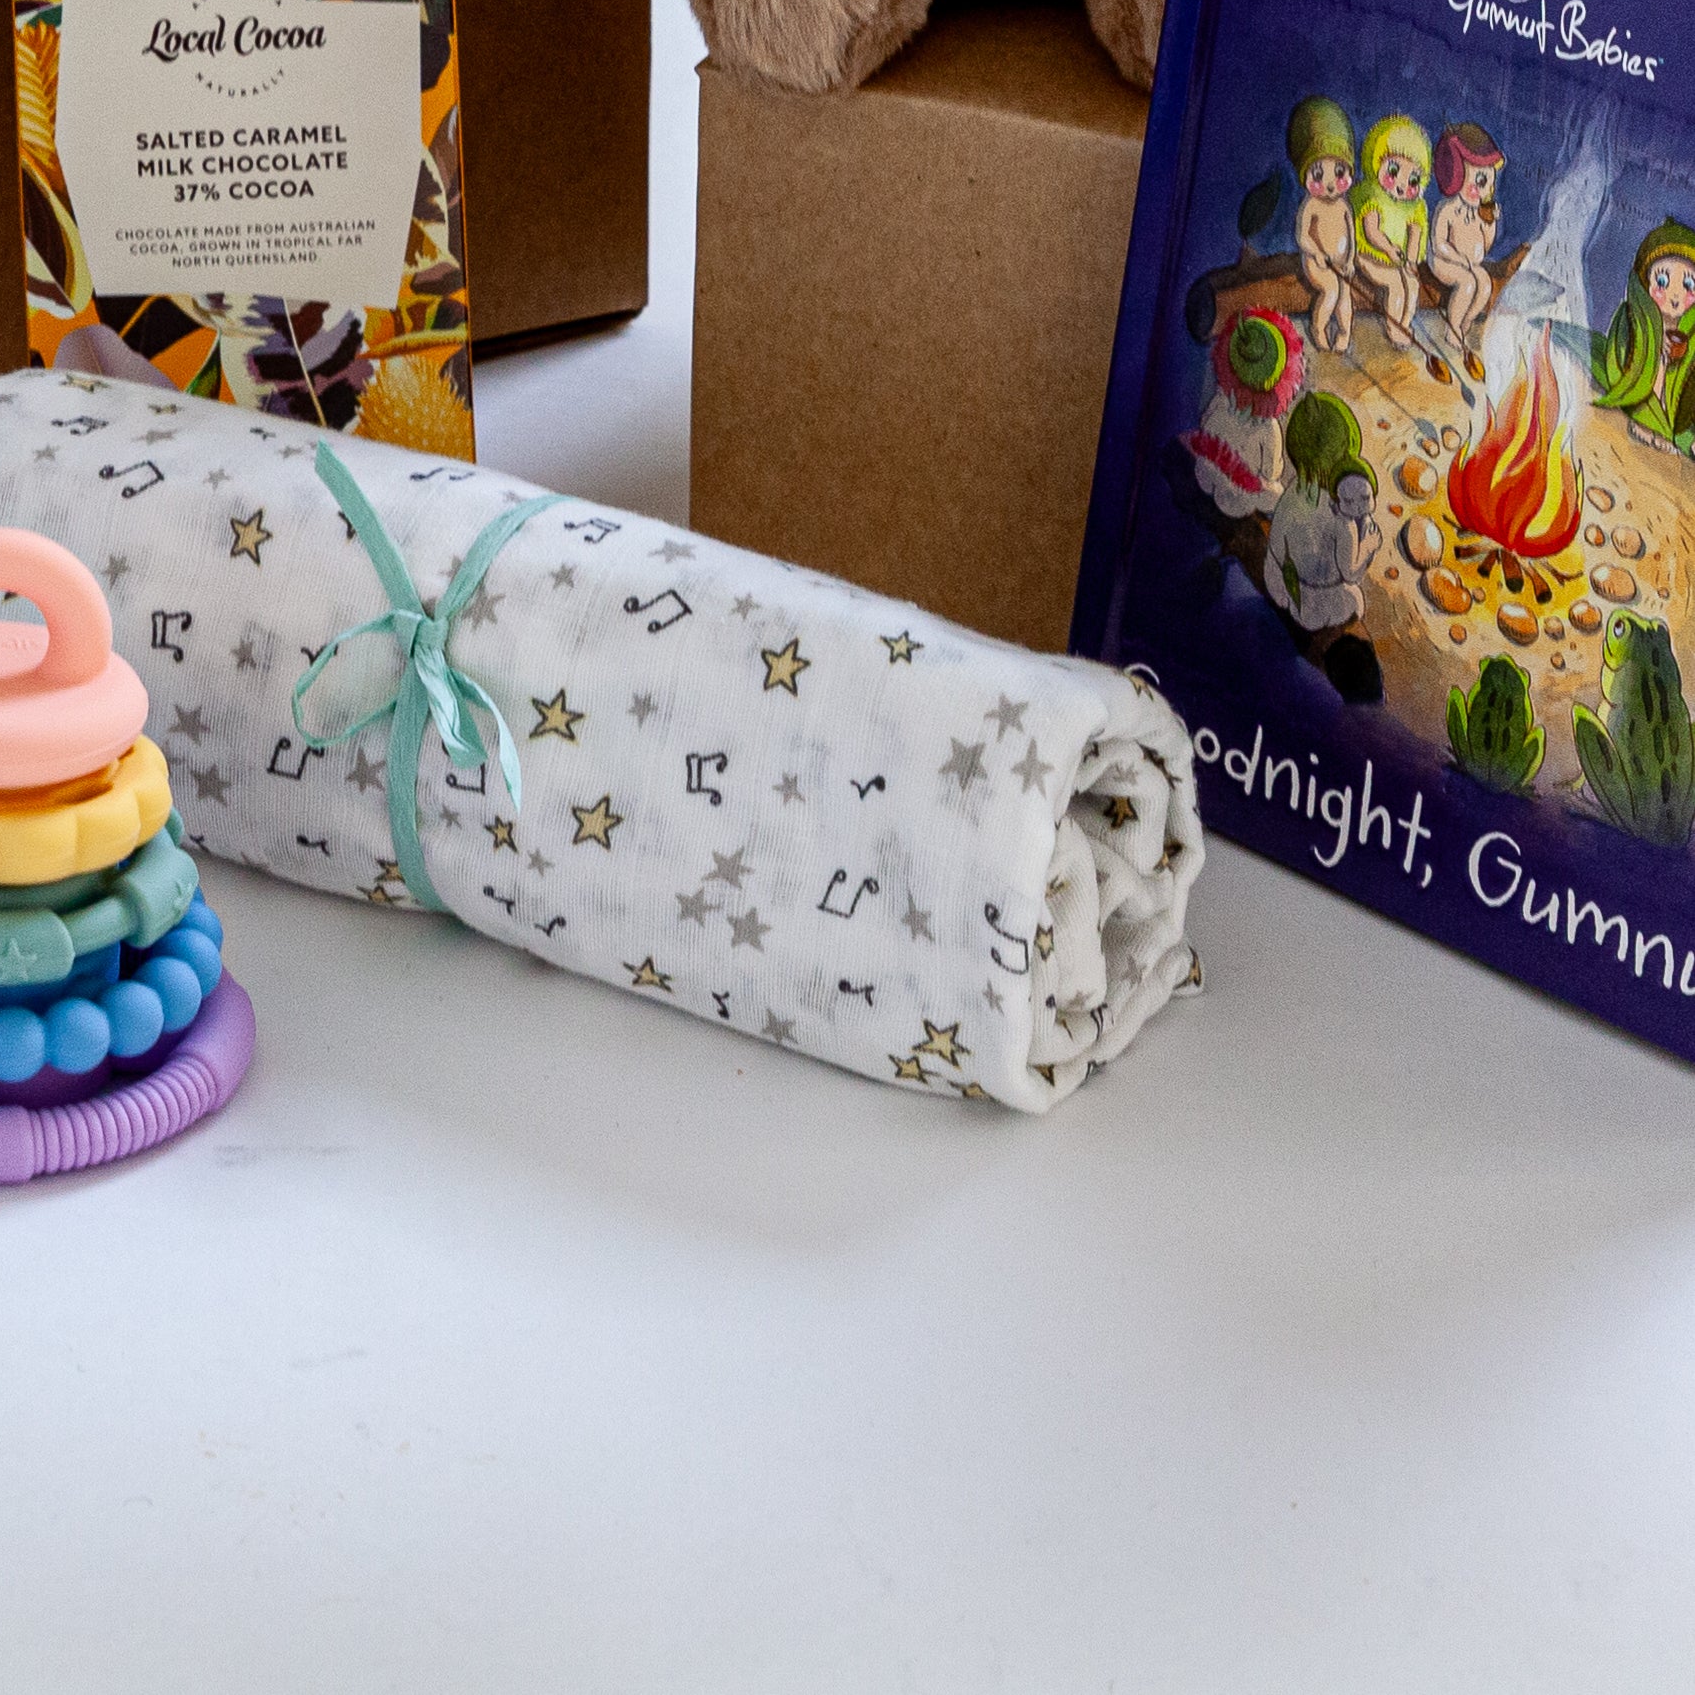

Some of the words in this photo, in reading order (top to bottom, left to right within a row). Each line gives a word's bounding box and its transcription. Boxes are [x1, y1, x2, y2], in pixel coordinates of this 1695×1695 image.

[142, 13, 227, 63] Local
[233, 15, 327, 57] Cocoa
[195, 66, 286, 98] NATURALLY
[135, 128, 226, 152] SALTED
[232, 124, 348, 148] CARAMEL
[137, 156, 195, 178] MILK
[202, 150, 349, 176] CHOCOLATE
[173, 183, 221, 204] 37%
[228, 178, 315, 201] COCOA
[114, 225, 200, 242] CHOCOLATE
[203, 223, 243, 238] MADE
[246, 222, 285, 236] FROM
[289, 218, 377, 234] AUSTRALIAN
[129, 242, 184, 257] COCOA,
[188, 239, 242, 254] GROWN
[246, 238, 261, 251] IN
[265, 235, 333, 250] TROPICAL
[337, 234, 364, 247] FAR
[171, 255, 221, 269] NORTH
